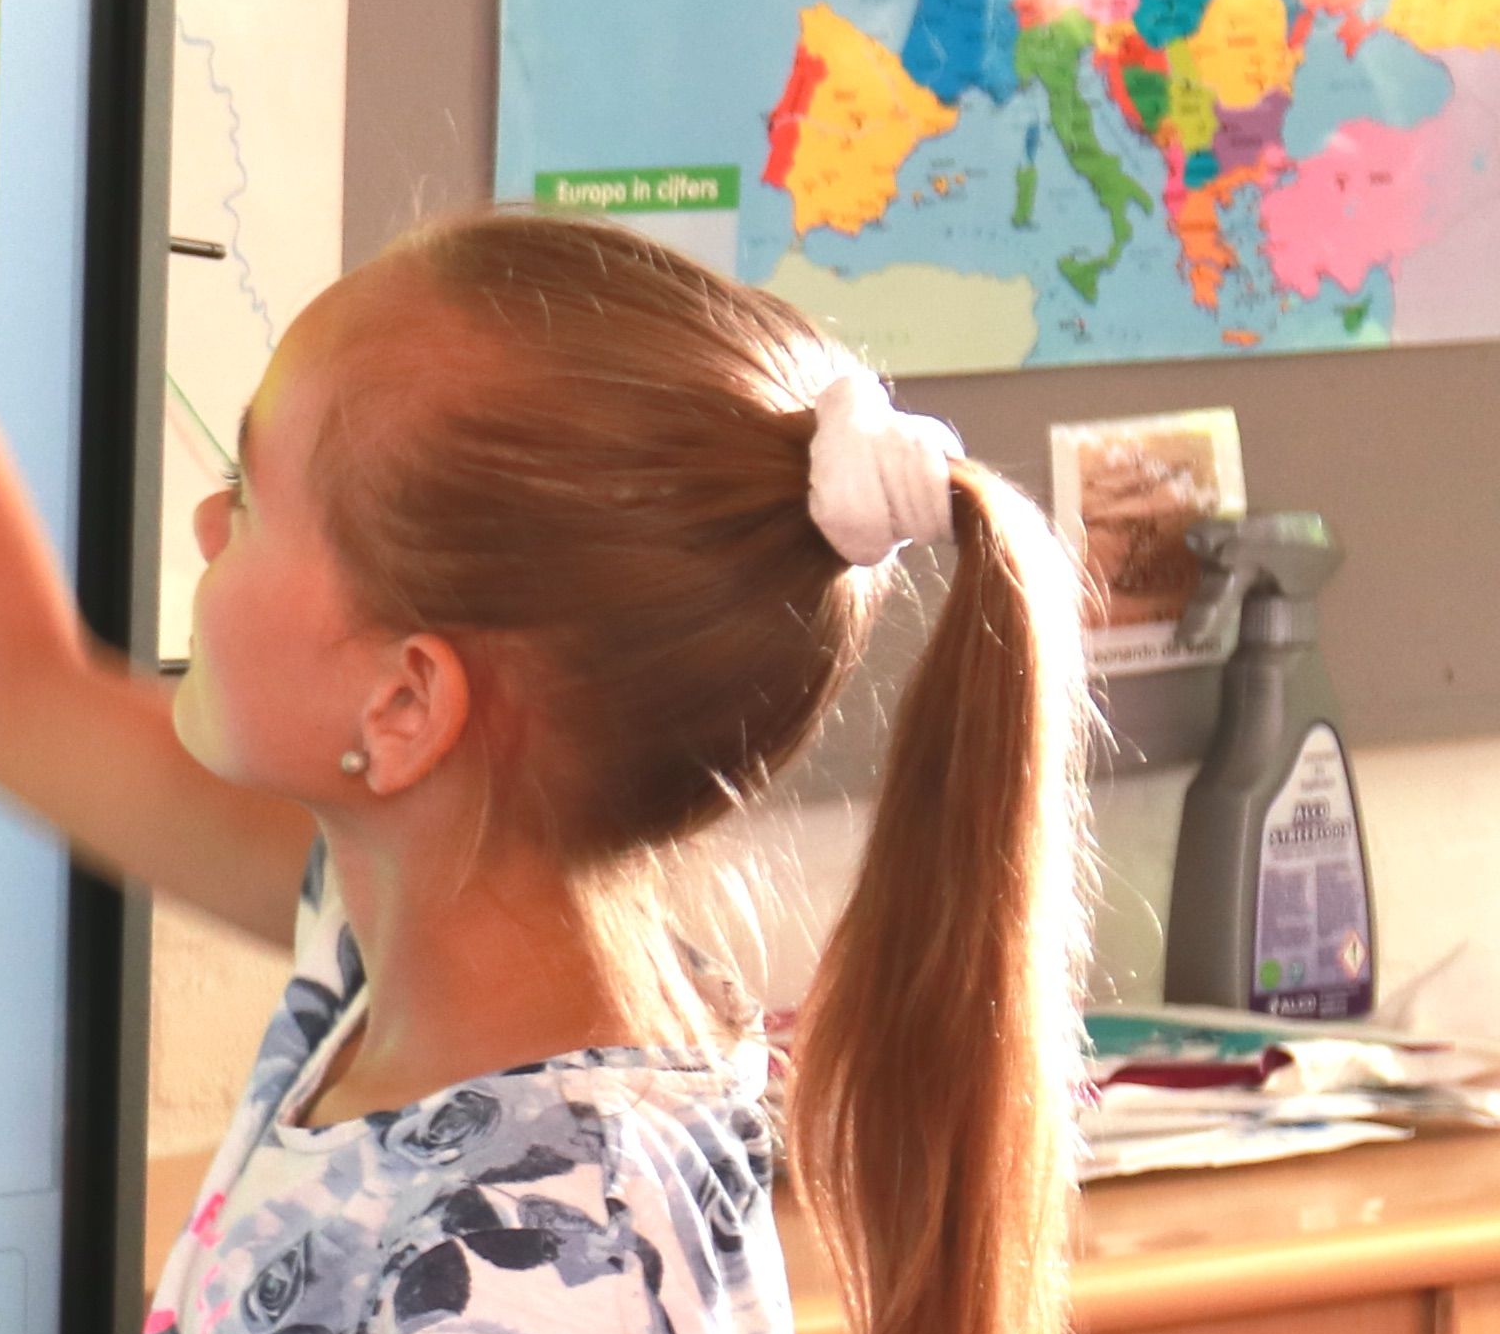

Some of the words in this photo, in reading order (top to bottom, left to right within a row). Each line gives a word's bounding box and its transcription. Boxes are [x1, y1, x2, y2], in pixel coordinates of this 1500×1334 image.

[556, 178, 627, 210] Europa
[632, 175, 651, 203] in
[656, 173, 719, 208] cijfers
[1092, 644, 1158, 664] eonardo
